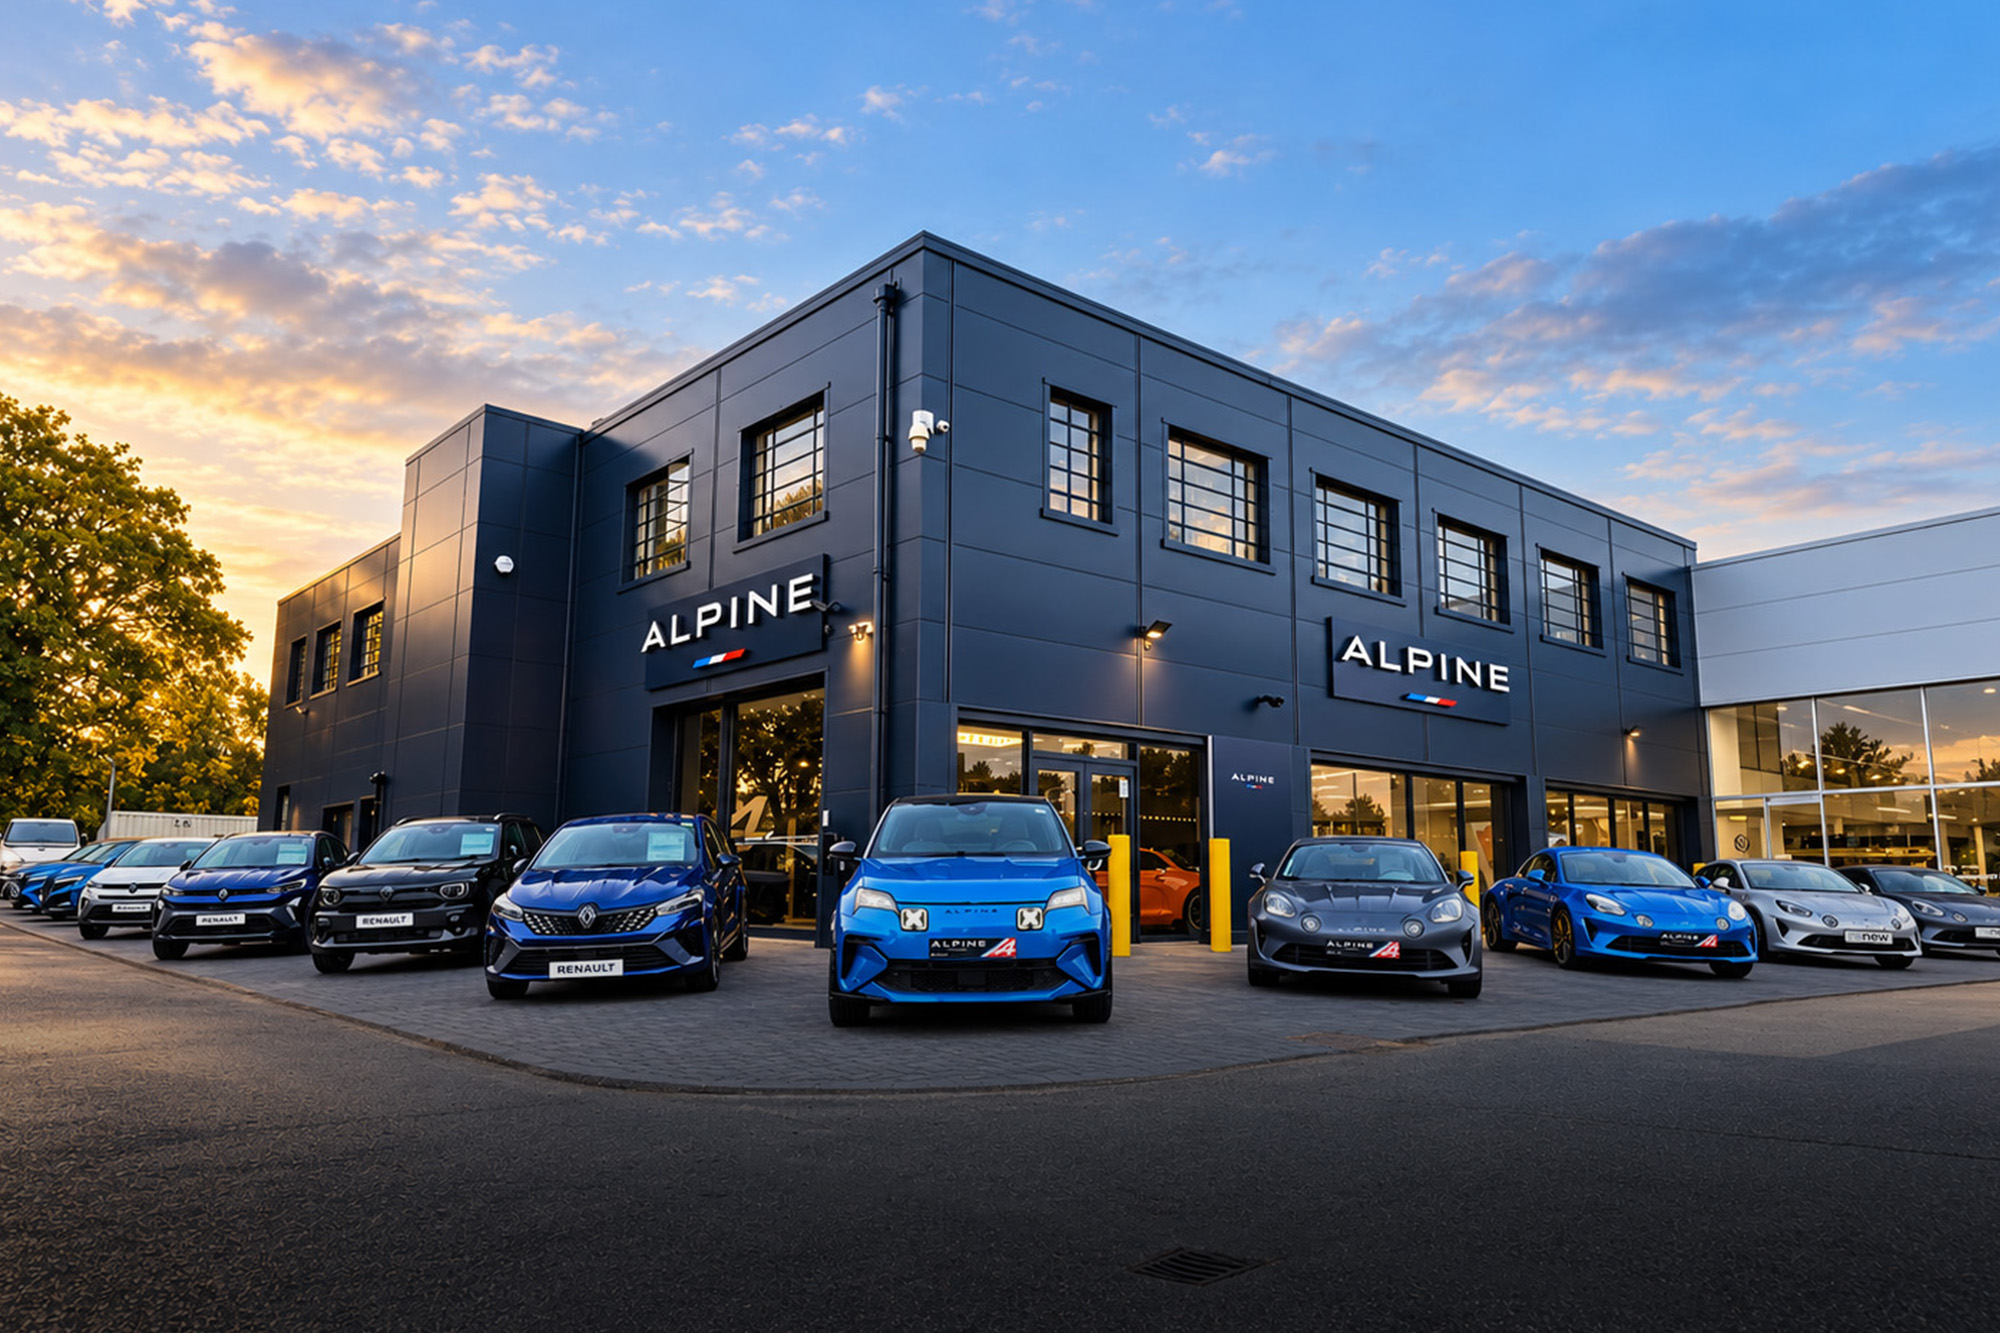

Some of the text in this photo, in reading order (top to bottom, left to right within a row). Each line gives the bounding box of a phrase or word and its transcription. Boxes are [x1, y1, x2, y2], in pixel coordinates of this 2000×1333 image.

[641, 573, 813, 653] ALPINE
[1341, 635, 1510, 692] ALPINE
[1231, 773, 1274, 784] ALPINE
[930, 940, 987, 948] ALPINE
[1326, 940, 1374, 949] ALPINE
[557, 963, 616, 974] RENAULT
